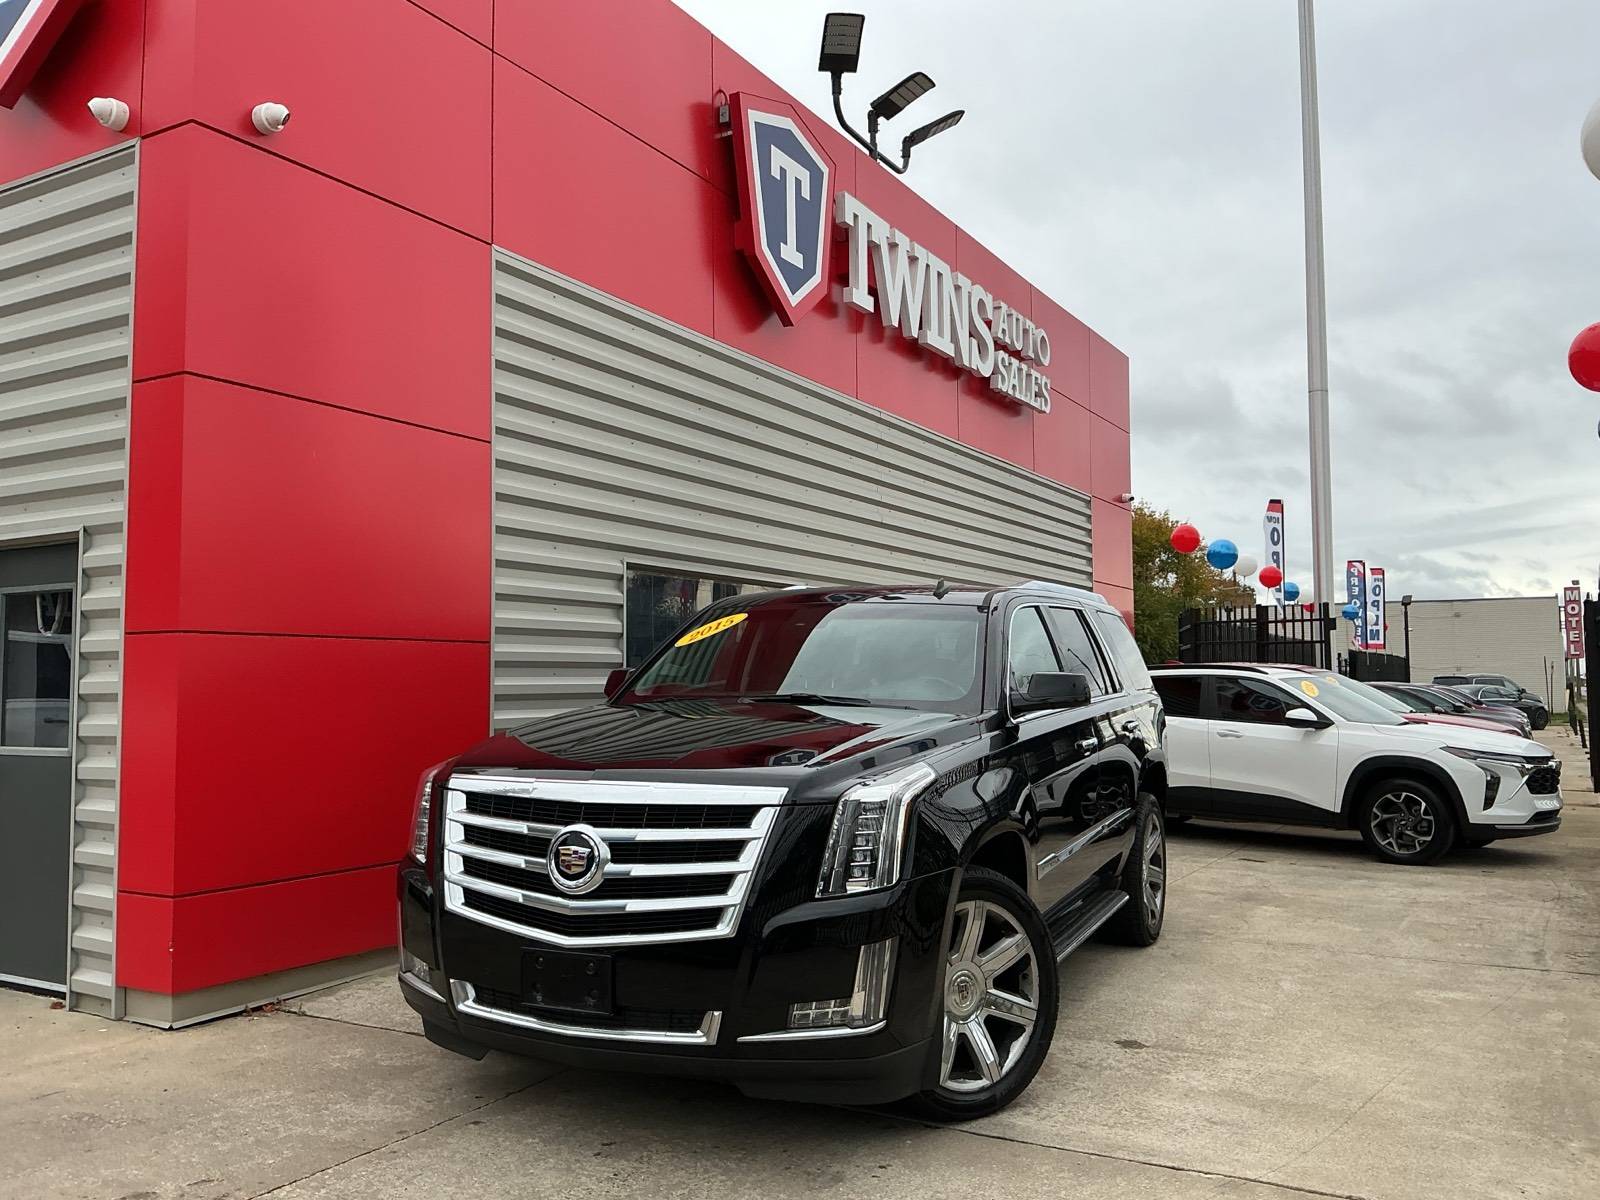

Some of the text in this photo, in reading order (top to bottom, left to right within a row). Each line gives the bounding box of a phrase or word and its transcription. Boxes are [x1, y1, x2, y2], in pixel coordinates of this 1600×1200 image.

[771, 143, 810, 270] T
[836, 191, 994, 378] TWINS
[991, 299, 1050, 367] AUTO
[990, 350, 1050, 414] SALES
[688, 618, 735, 642] 2015
[1565, 590, 1580, 655] MOTEL
